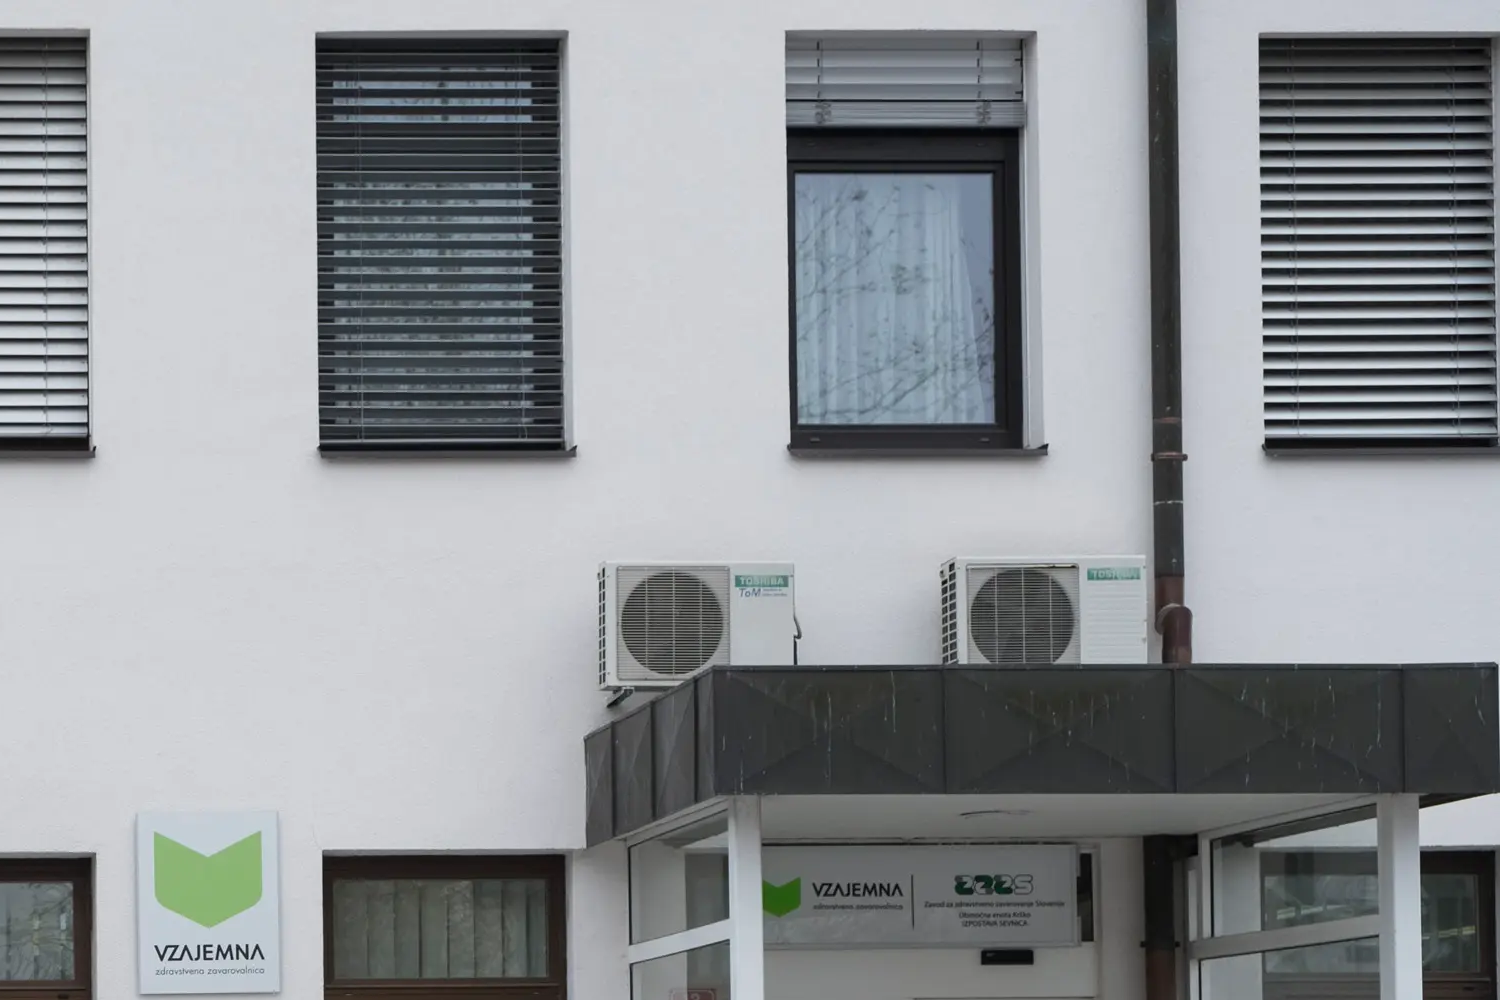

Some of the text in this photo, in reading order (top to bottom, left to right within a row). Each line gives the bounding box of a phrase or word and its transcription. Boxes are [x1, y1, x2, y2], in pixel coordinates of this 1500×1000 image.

[812, 882, 903, 897] VZAJEMNA
[999, 920, 1029, 928] SEVNICA
[154, 943, 265, 962] VZAJEMNA
[155, 965, 265, 976] zdravstvena zavarovalnica
